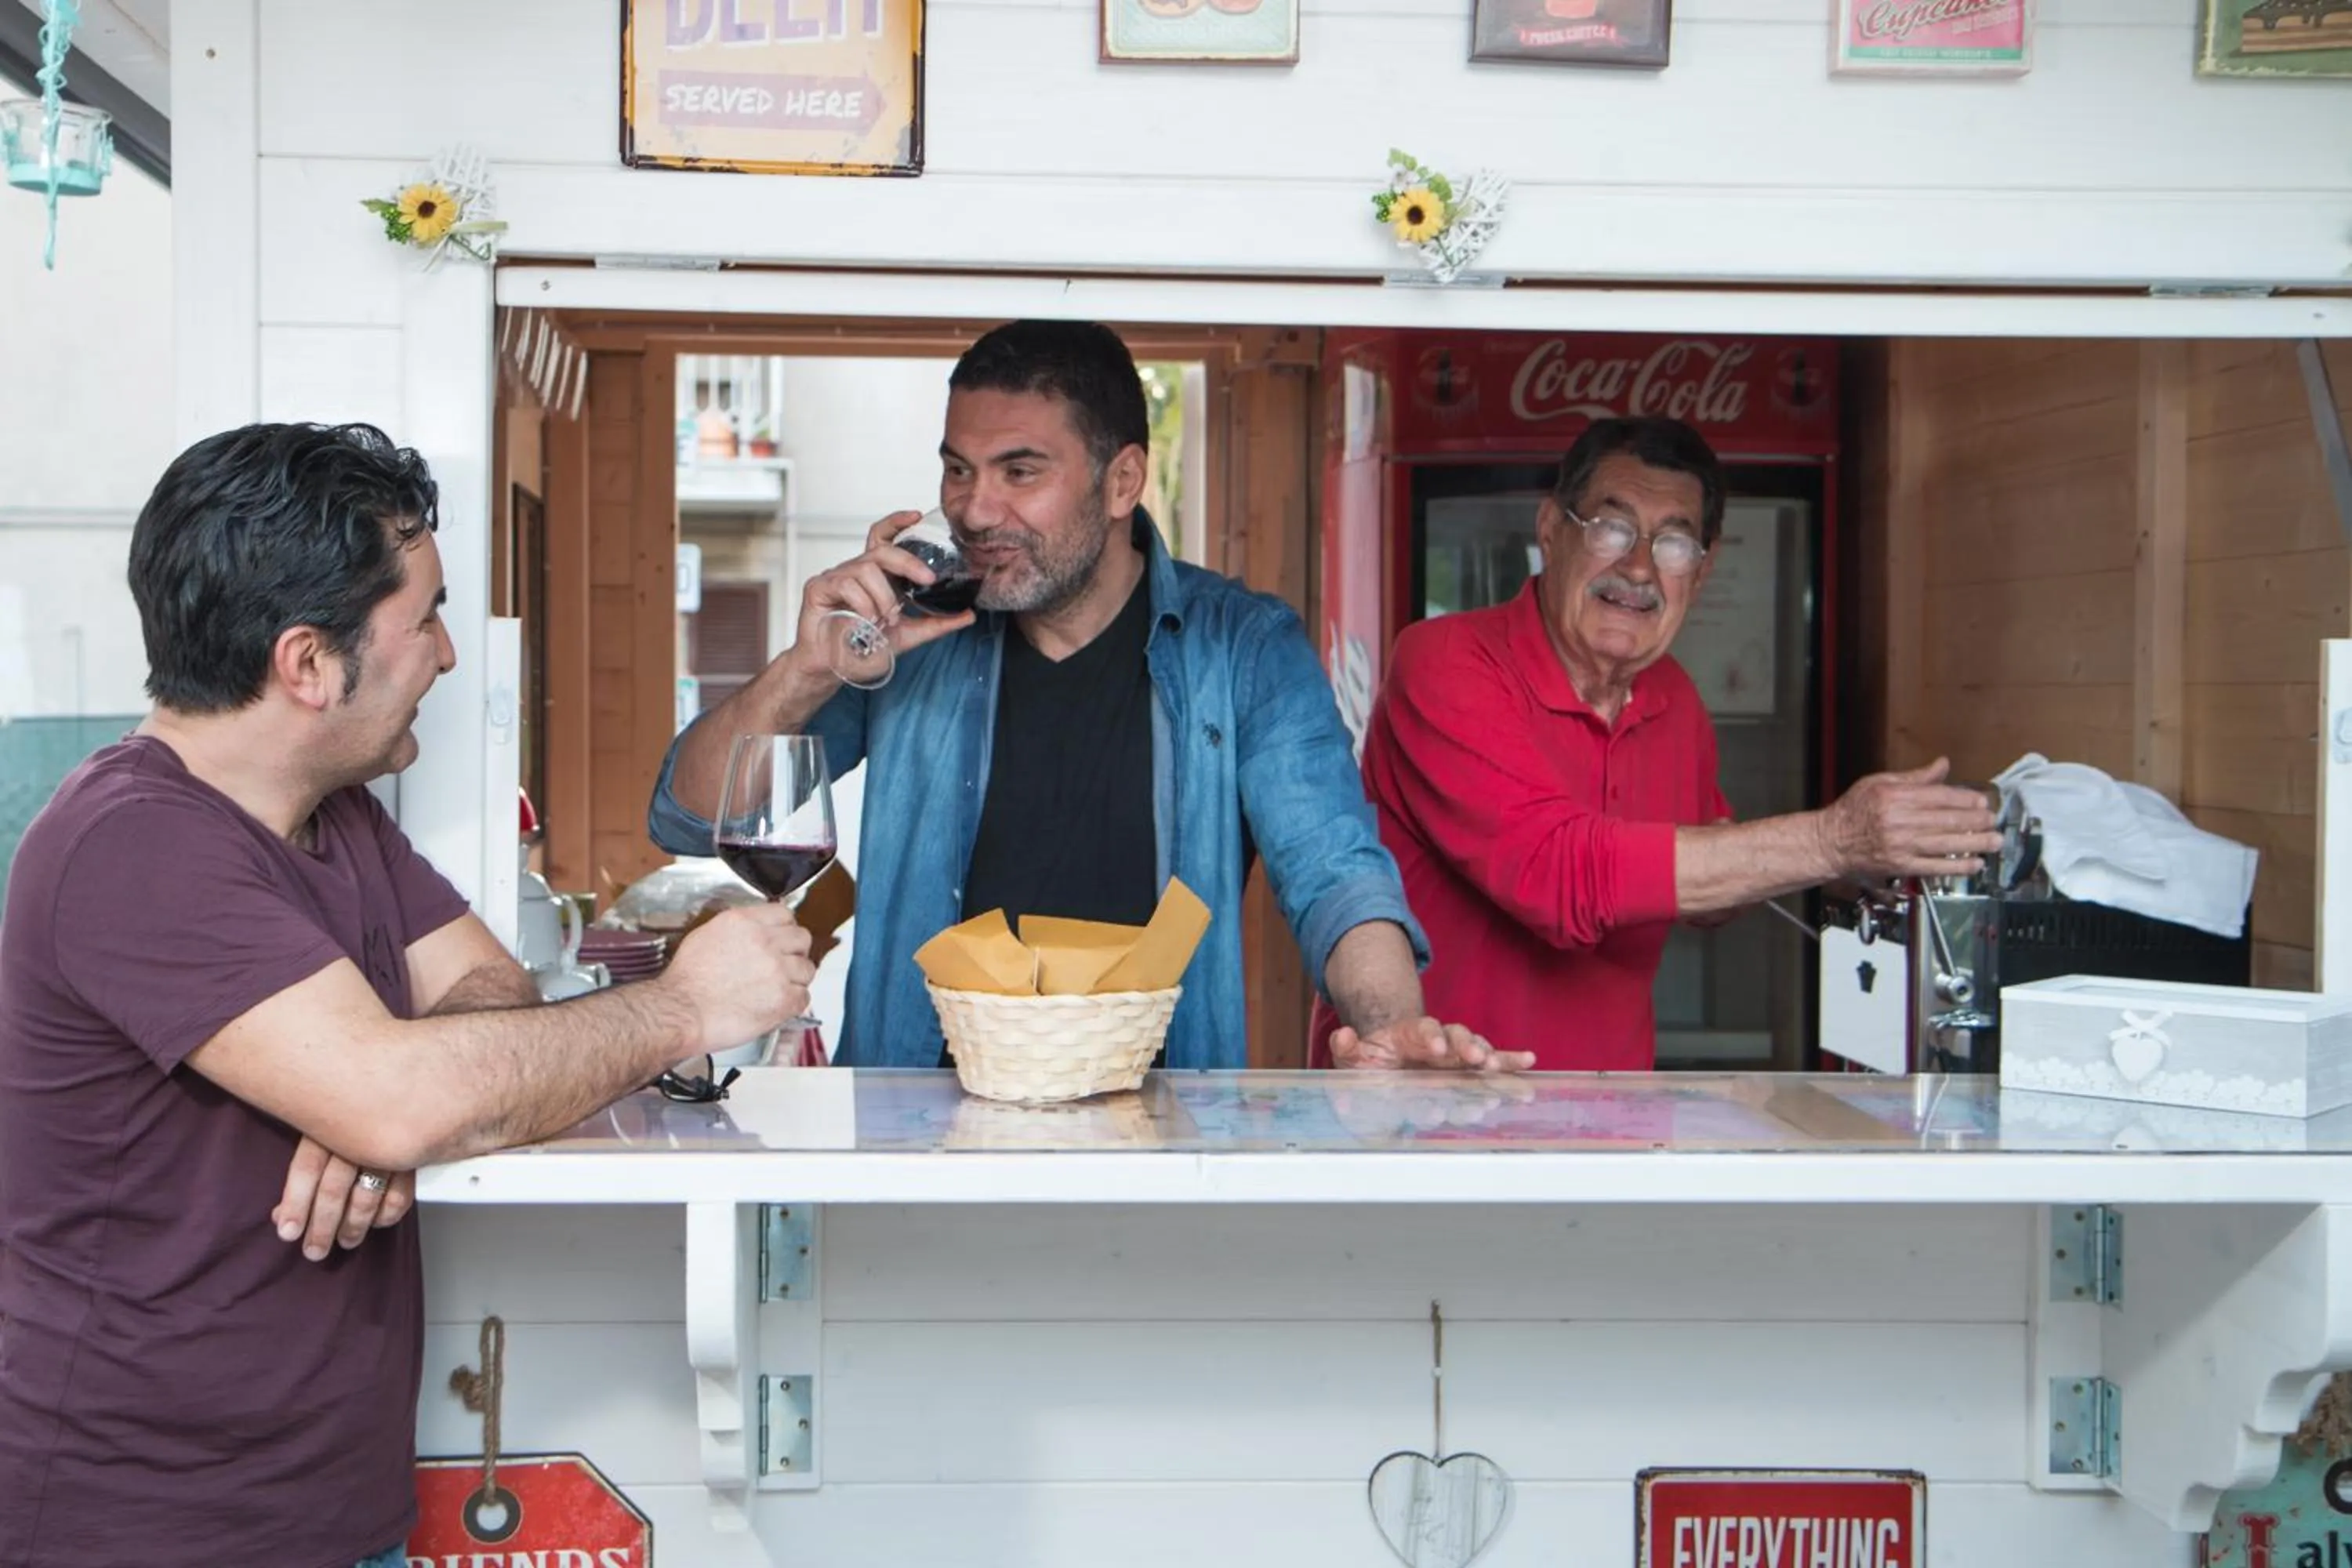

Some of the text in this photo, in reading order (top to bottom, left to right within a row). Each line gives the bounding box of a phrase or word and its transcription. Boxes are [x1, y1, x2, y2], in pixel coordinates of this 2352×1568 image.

[666, 83, 862, 118] SERVED HERE
[1509, 339, 1755, 422] Coca-Cola
[1674, 1516, 1900, 1568] EVERYTHING
